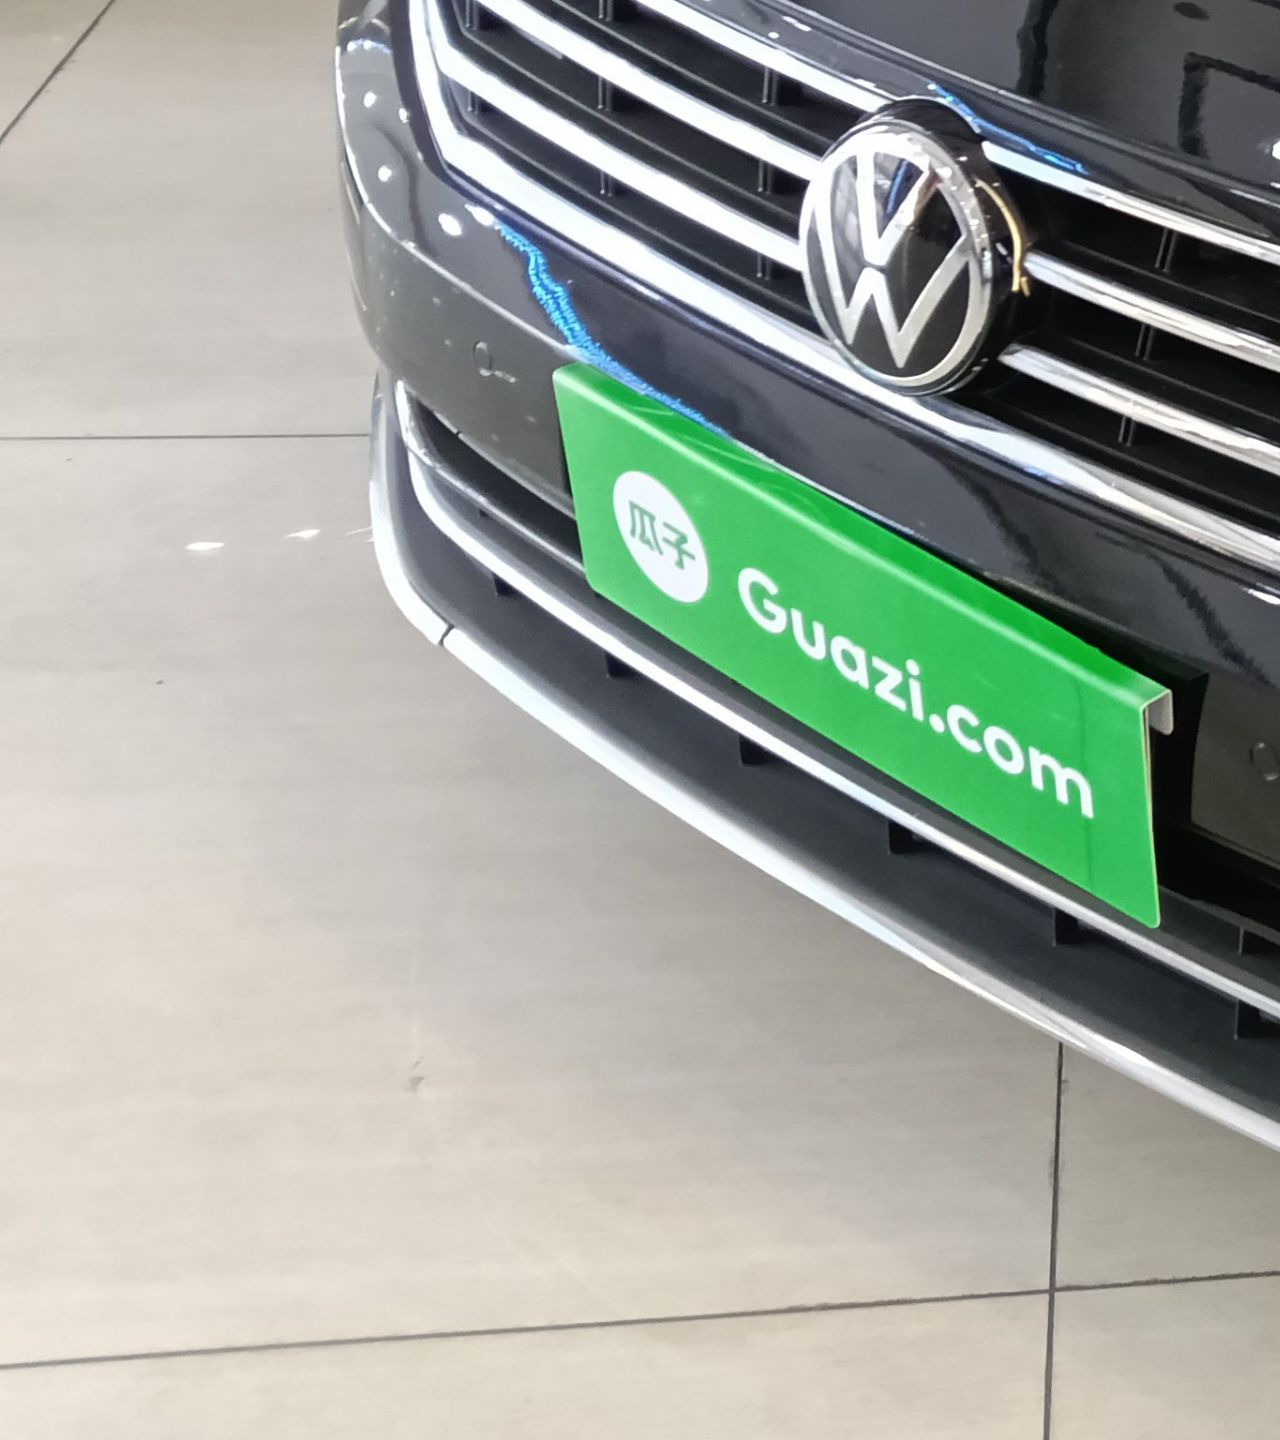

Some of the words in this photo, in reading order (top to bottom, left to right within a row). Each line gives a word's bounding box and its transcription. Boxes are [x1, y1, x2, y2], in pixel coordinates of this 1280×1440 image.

[804, 128, 986, 382] VW
[628, 499, 697, 571] 瓜子
[737, 565, 1096, 819] Guazi.com
